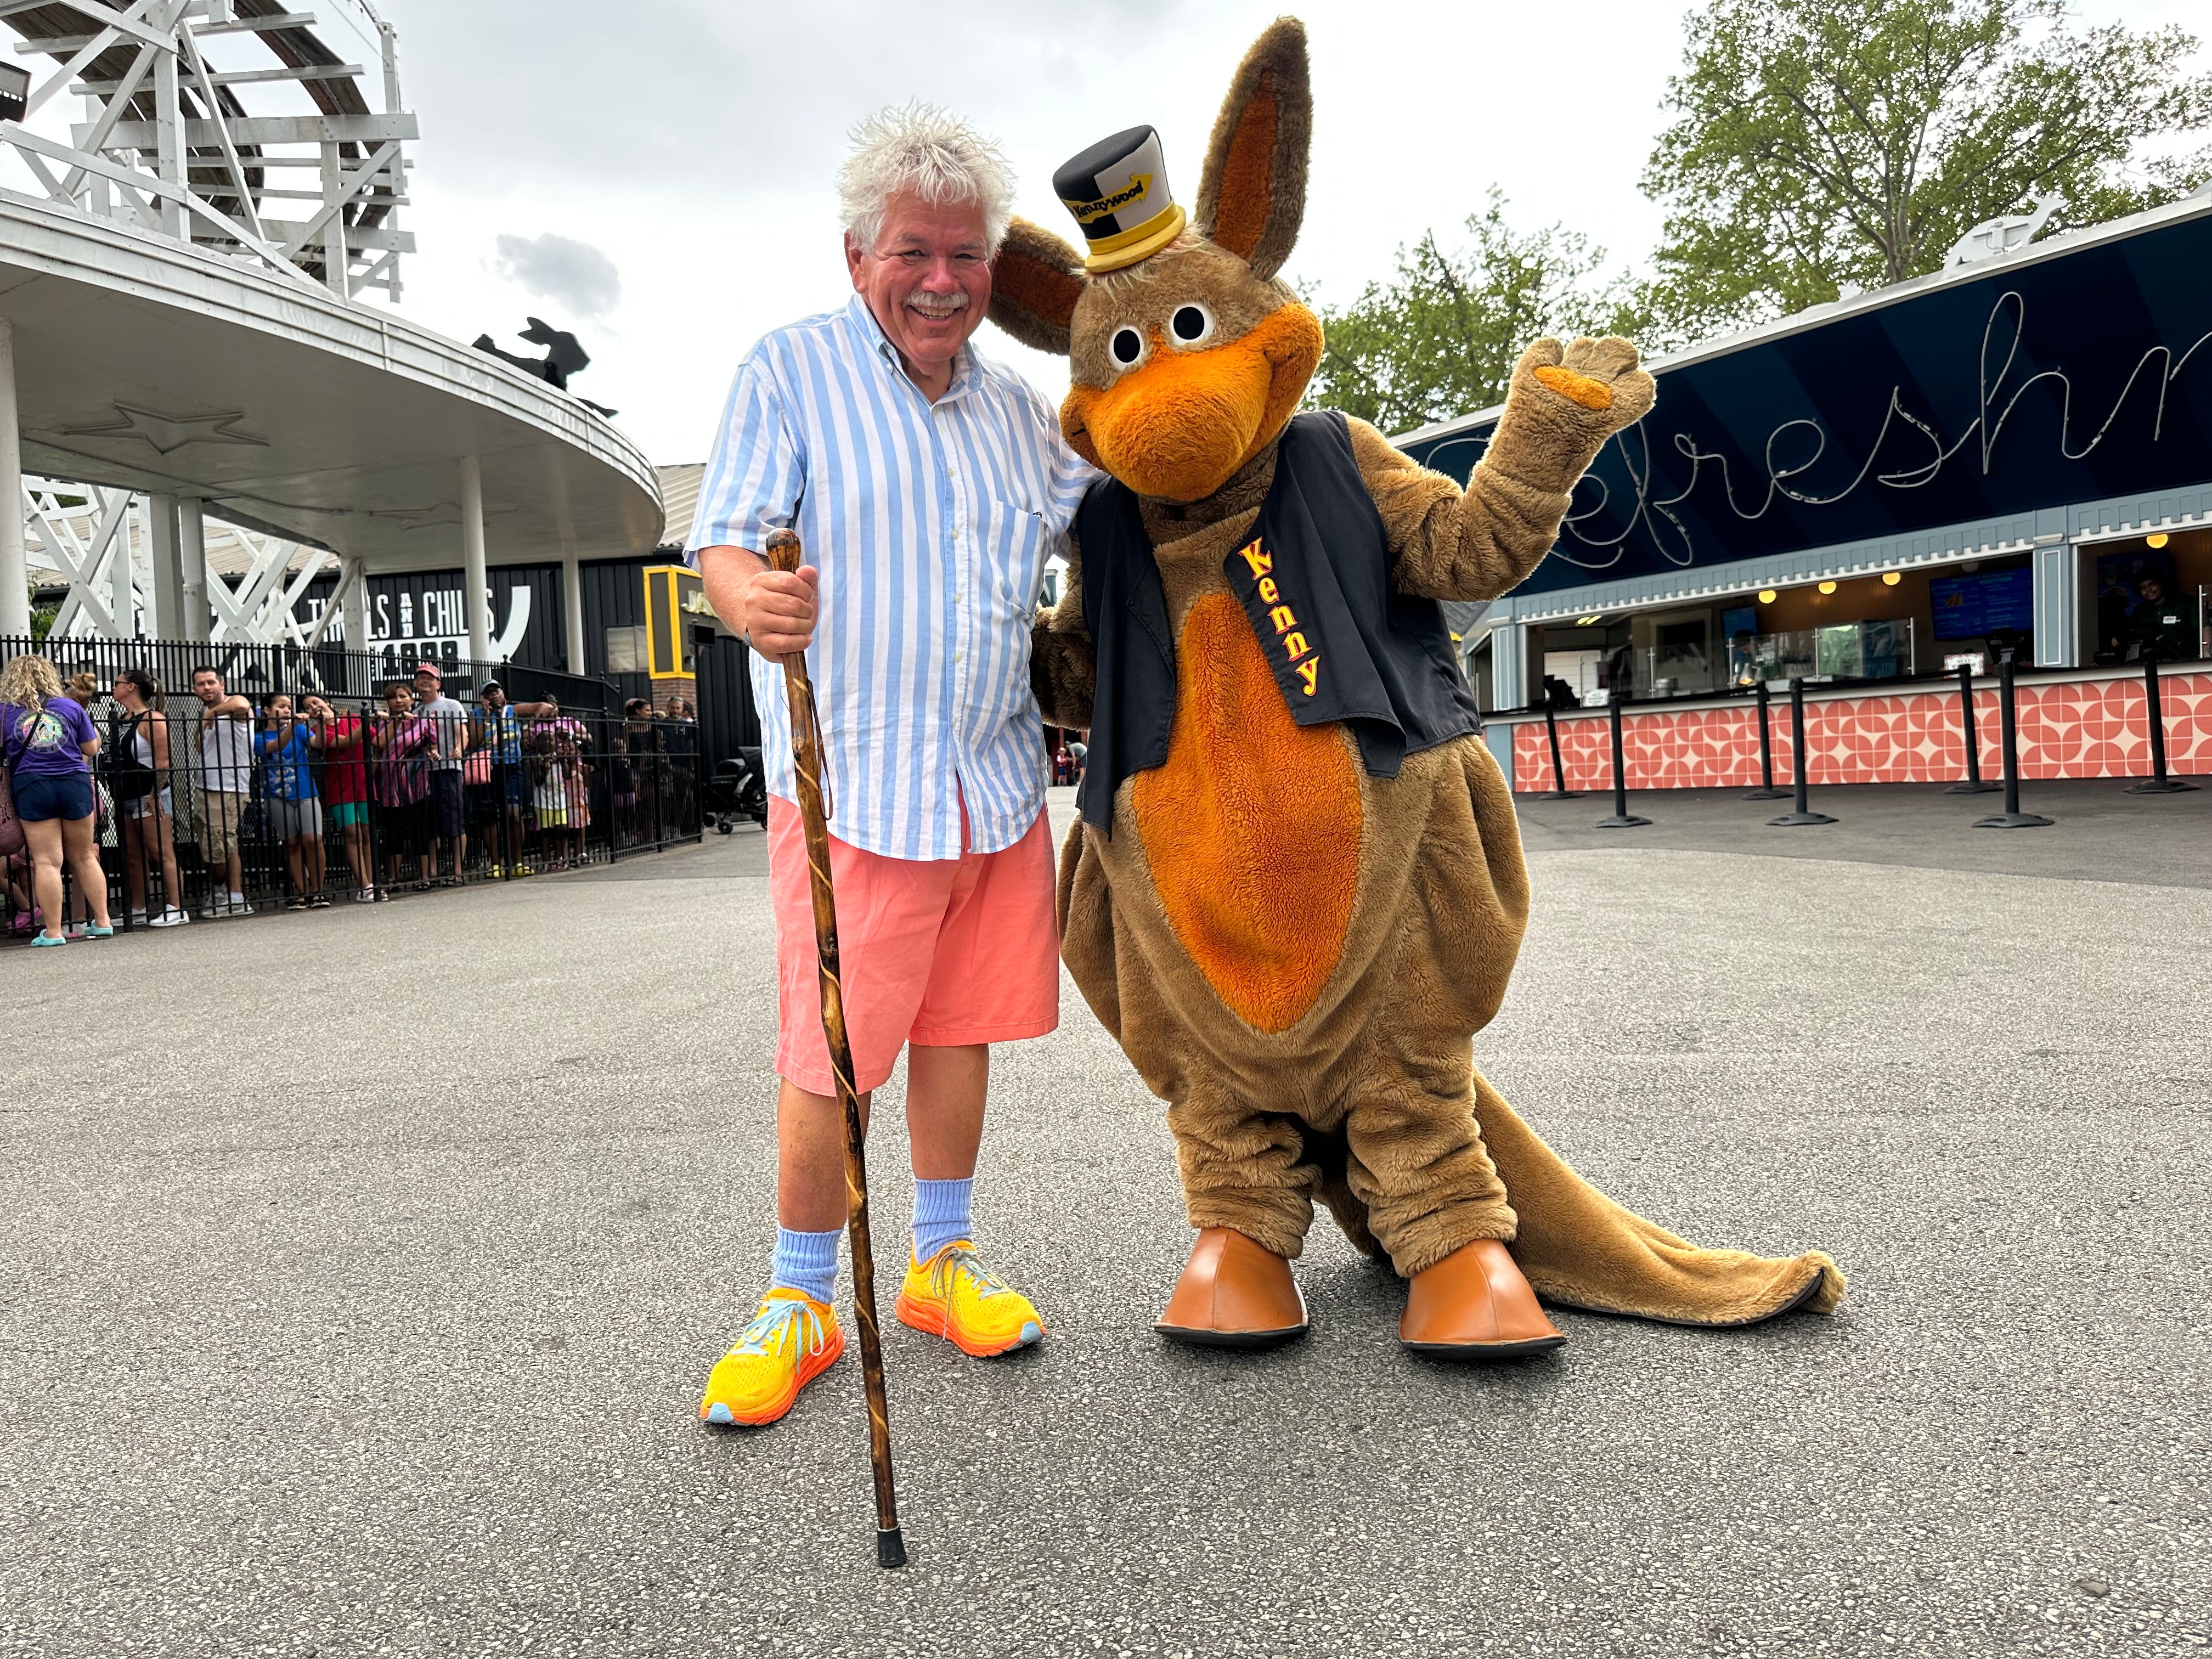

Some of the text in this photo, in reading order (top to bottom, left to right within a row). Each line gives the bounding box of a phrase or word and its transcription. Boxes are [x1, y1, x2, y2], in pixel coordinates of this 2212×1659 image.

[1425, 290, 2212, 568] efresh
[400, 592, 414, 638] AND
[423, 588, 495, 636] CHILS
[680, 590, 720, 619] JA
[1237, 535, 1321, 697] Kenny
